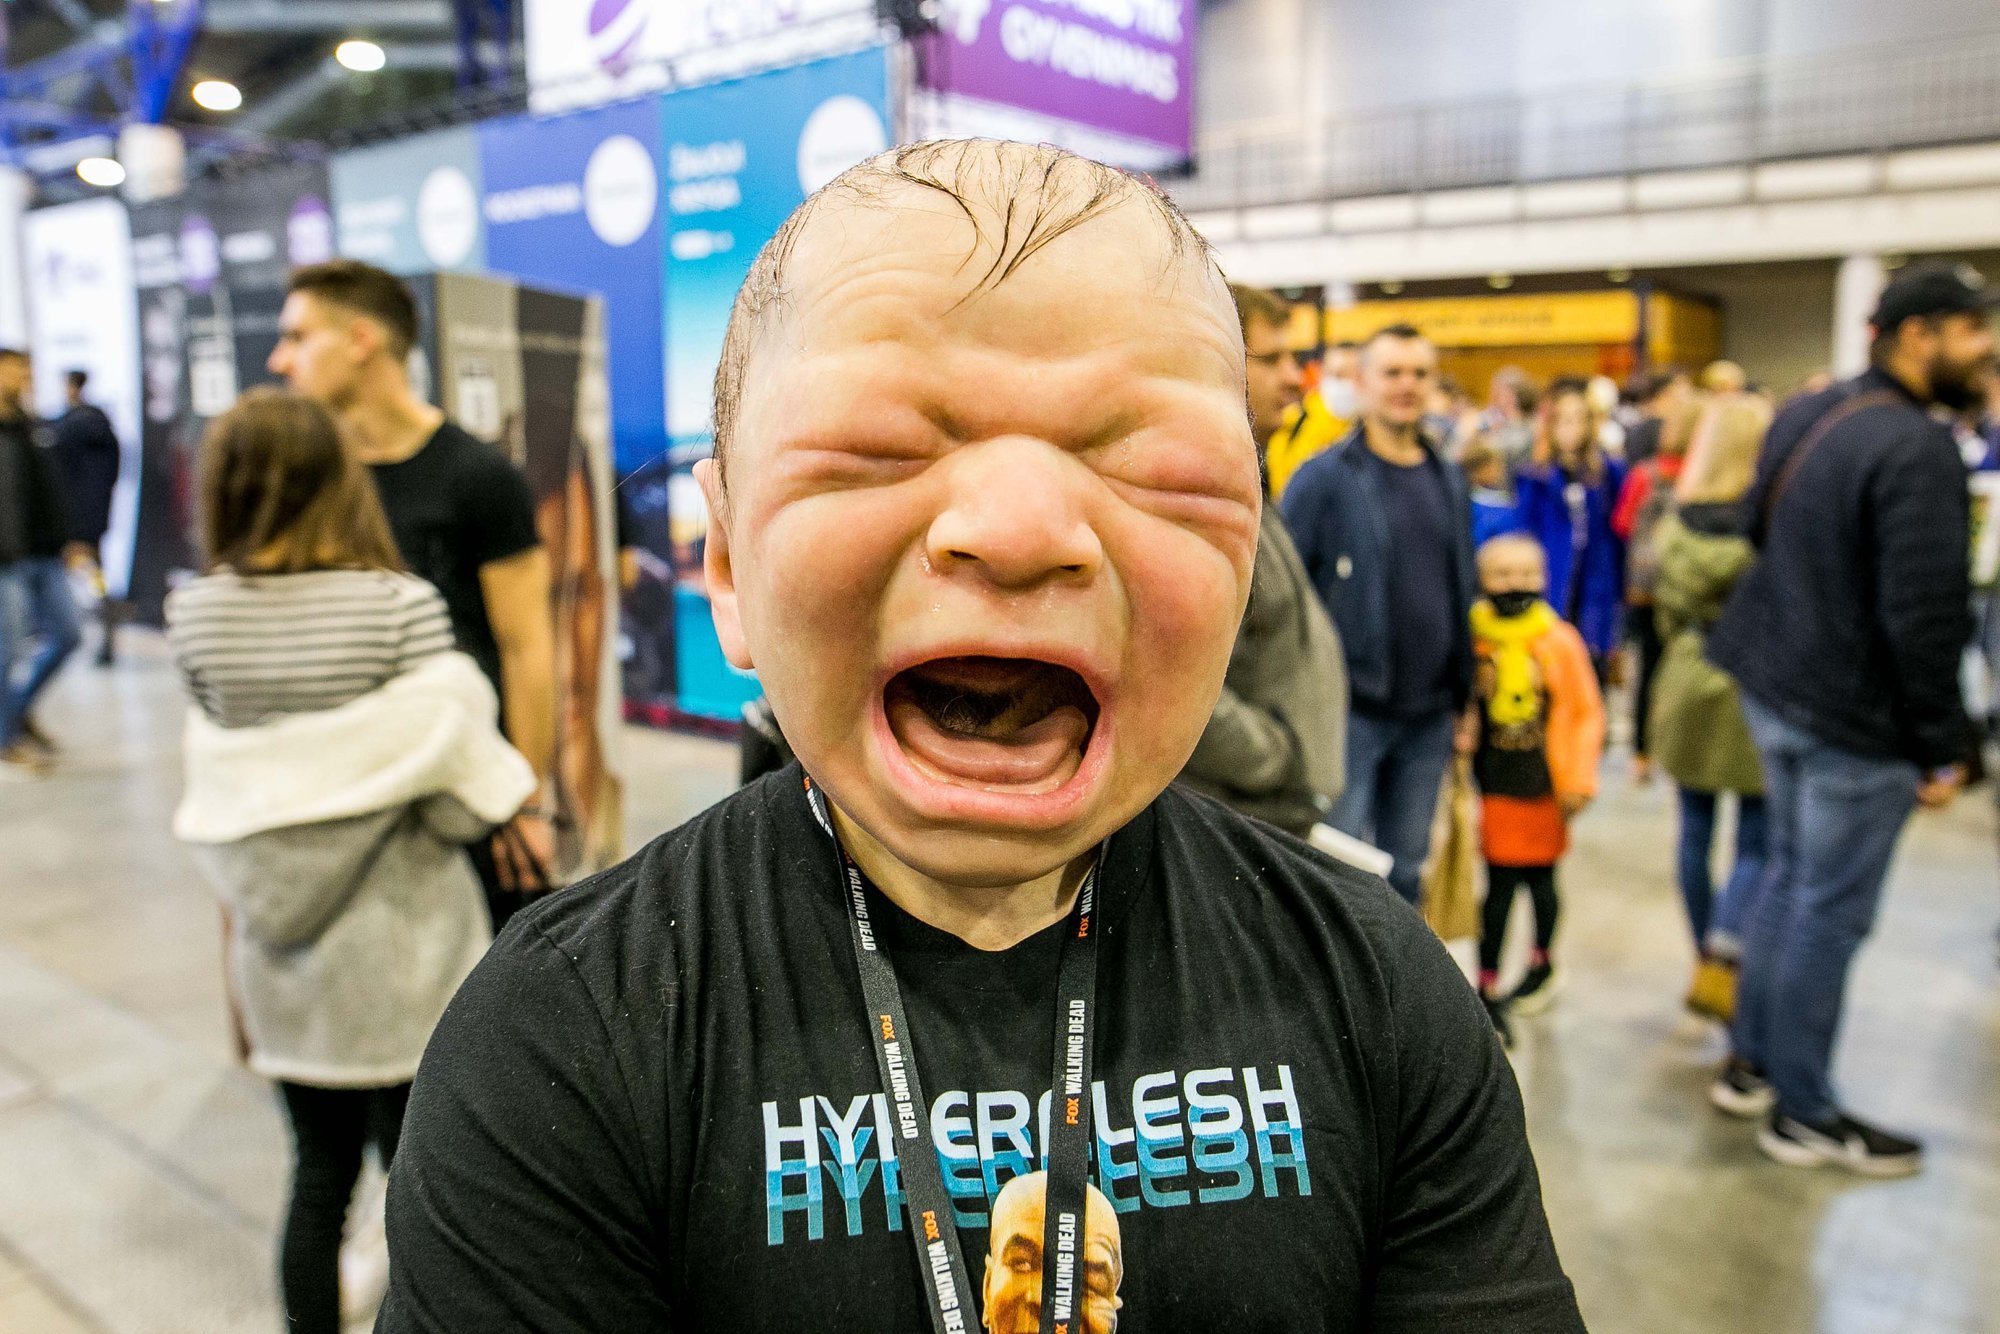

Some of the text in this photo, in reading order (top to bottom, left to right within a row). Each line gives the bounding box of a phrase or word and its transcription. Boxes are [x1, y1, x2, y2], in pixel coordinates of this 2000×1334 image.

[848, 867, 877, 951] WALKING DEAD
[1078, 916, 1090, 938] FOX
[880, 1014, 919, 1139] FOX WALKING DEAD
[1065, 1000, 1086, 1125] FOX WALKING DEAD
[922, 1210, 941, 1241] FOX
[1058, 1212, 1076, 1252] DEAD
[927, 1240, 960, 1311] WALKING
[1054, 1252, 1075, 1320] WALKING
